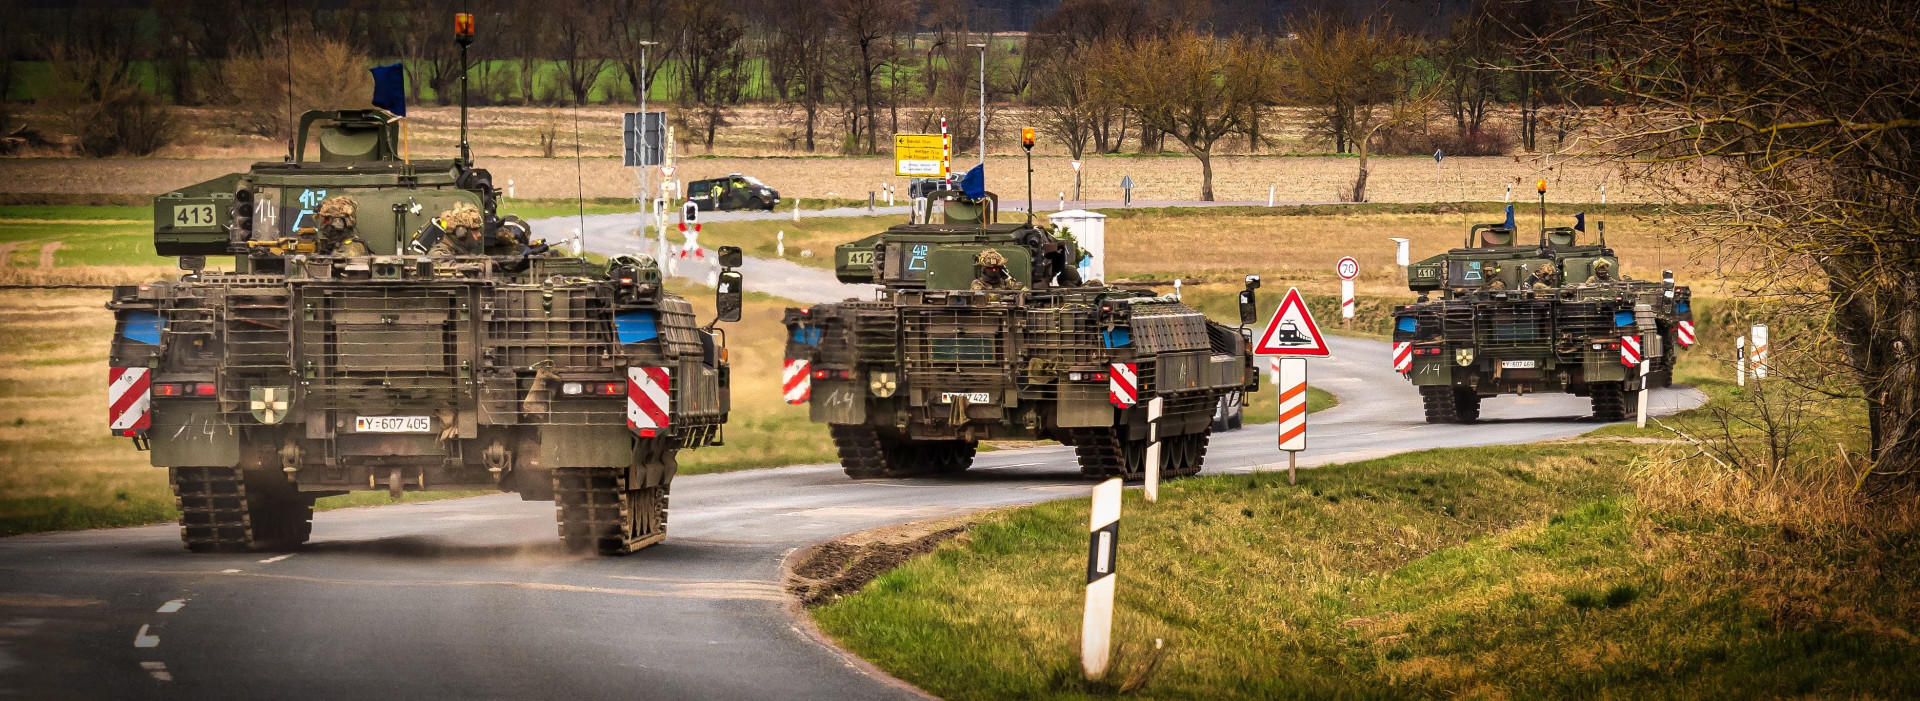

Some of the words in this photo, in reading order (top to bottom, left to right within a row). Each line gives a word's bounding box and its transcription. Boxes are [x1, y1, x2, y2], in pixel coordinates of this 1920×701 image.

[177, 206, 214, 224] 413
[850, 252, 874, 264] 412
[1341, 263, 1355, 274] 70
[973, 393, 988, 402] 422
[406, 418, 428, 429] 405
